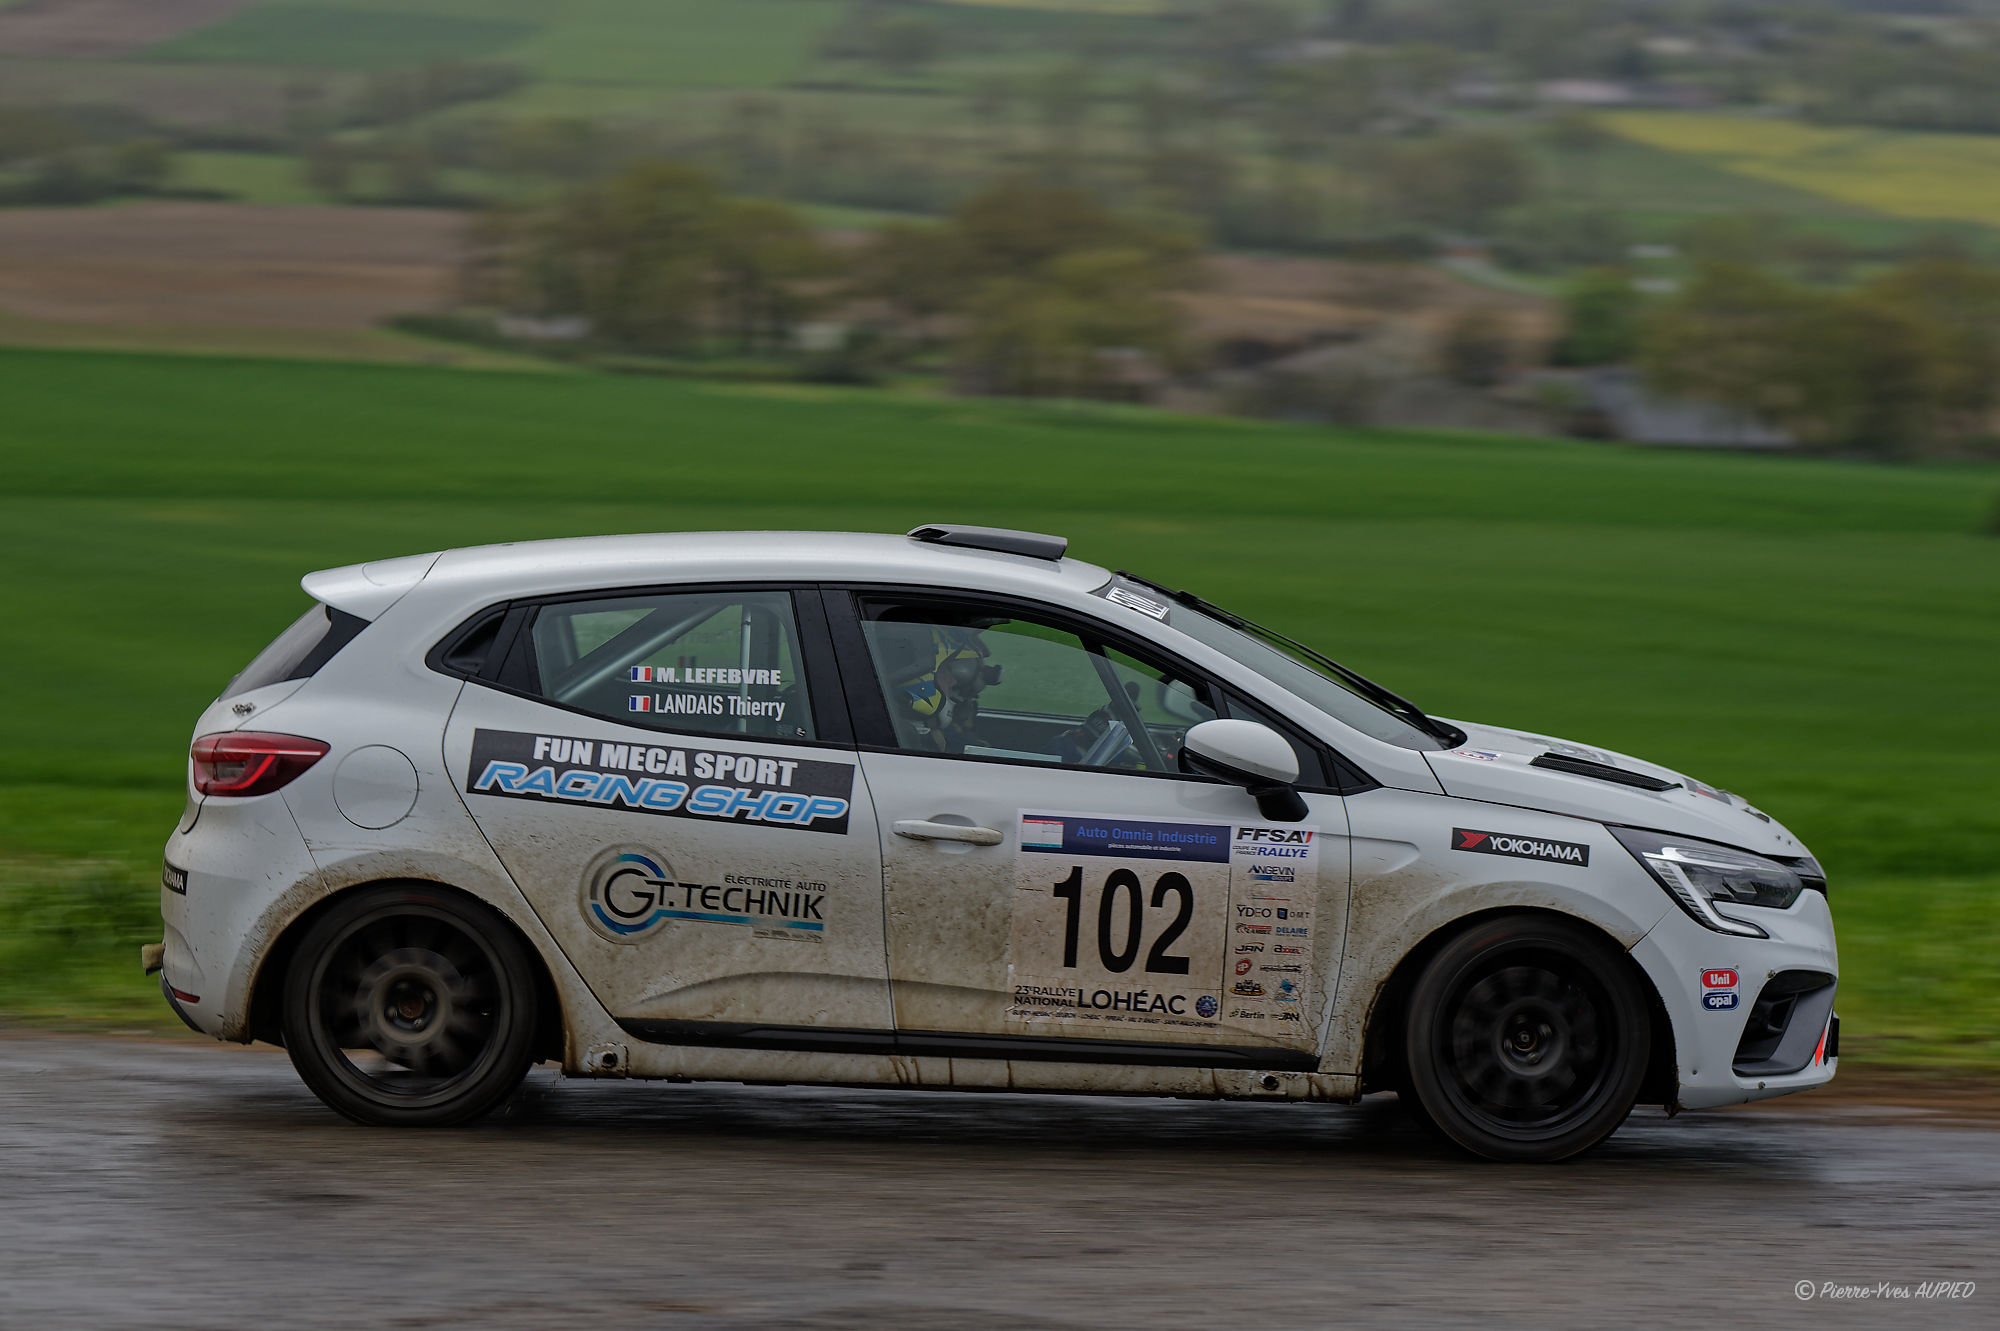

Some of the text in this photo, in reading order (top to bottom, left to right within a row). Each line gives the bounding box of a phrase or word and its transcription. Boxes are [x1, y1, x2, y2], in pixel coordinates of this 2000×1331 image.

[656, 667, 781, 685] M. LEFEBVRE
[655, 693, 786, 721] LANDAIS Thierry
[533, 736, 798, 787] FUN MECA SPORT
[474, 760, 850, 825] RACING SHOP
[1077, 825, 1217, 845] Auto Omnia Industrie
[1236, 827, 1304, 843] FFSA
[1257, 846, 1309, 858] RALLYE
[1489, 836, 1583, 862] YOKOHAMA
[1247, 864, 1295, 876] ANGEVIN
[796, 880, 827, 892] AUTO
[1236, 906, 1272, 918] YDEO
[1053, 865, 1194, 975] 102
[1276, 926, 1308, 935] DELAIRE
[1710, 973, 1730, 985] Unil
[1014, 996, 1075, 1008] NATIONAL
[1077, 988, 1187, 1015] LOHÉAC
[1708, 995, 1733, 1008] opal
[1239, 1010, 1265, 1020] Bertin
